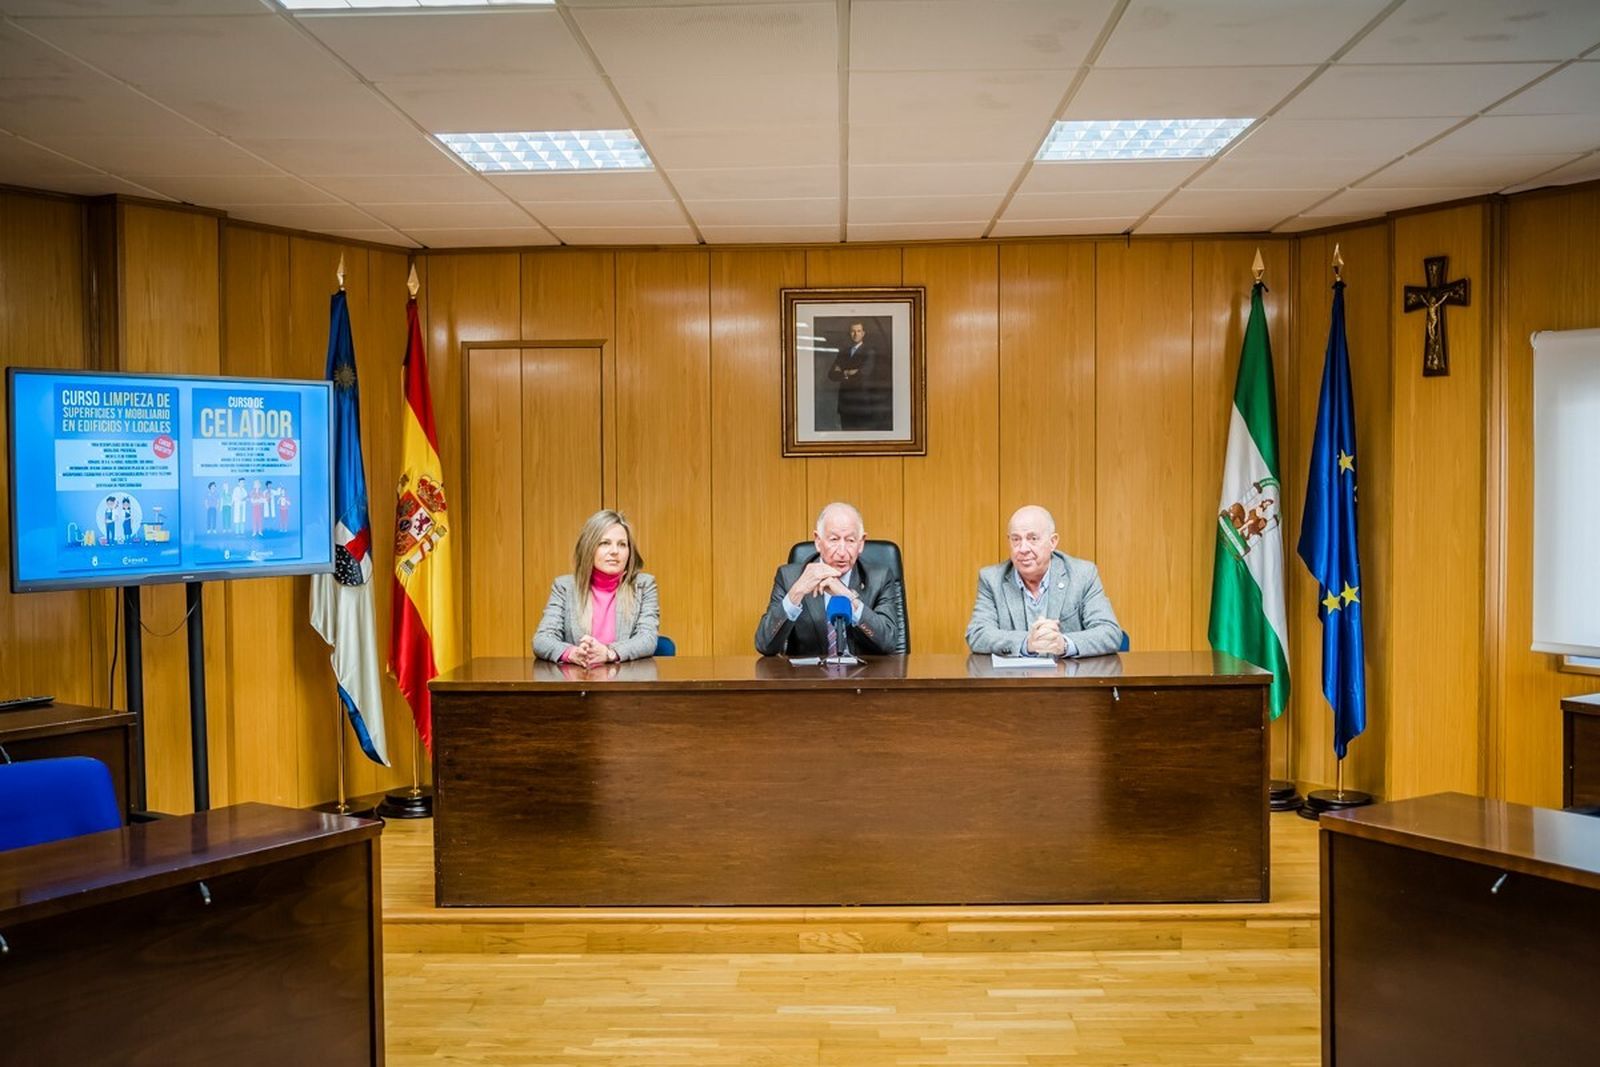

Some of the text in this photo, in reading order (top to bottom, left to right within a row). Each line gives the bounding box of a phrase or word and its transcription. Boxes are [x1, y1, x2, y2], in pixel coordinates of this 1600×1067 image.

[62, 390, 170, 408] CURSO LIMPIEZA DE
[228, 396, 264, 409] CURSO DE
[63, 407, 170, 420] SUPERFICIES Y MOBILIARIO
[63, 420, 171, 433] EN EDIFICIOS Y LOCALES
[201, 408, 292, 438] CELADOR
